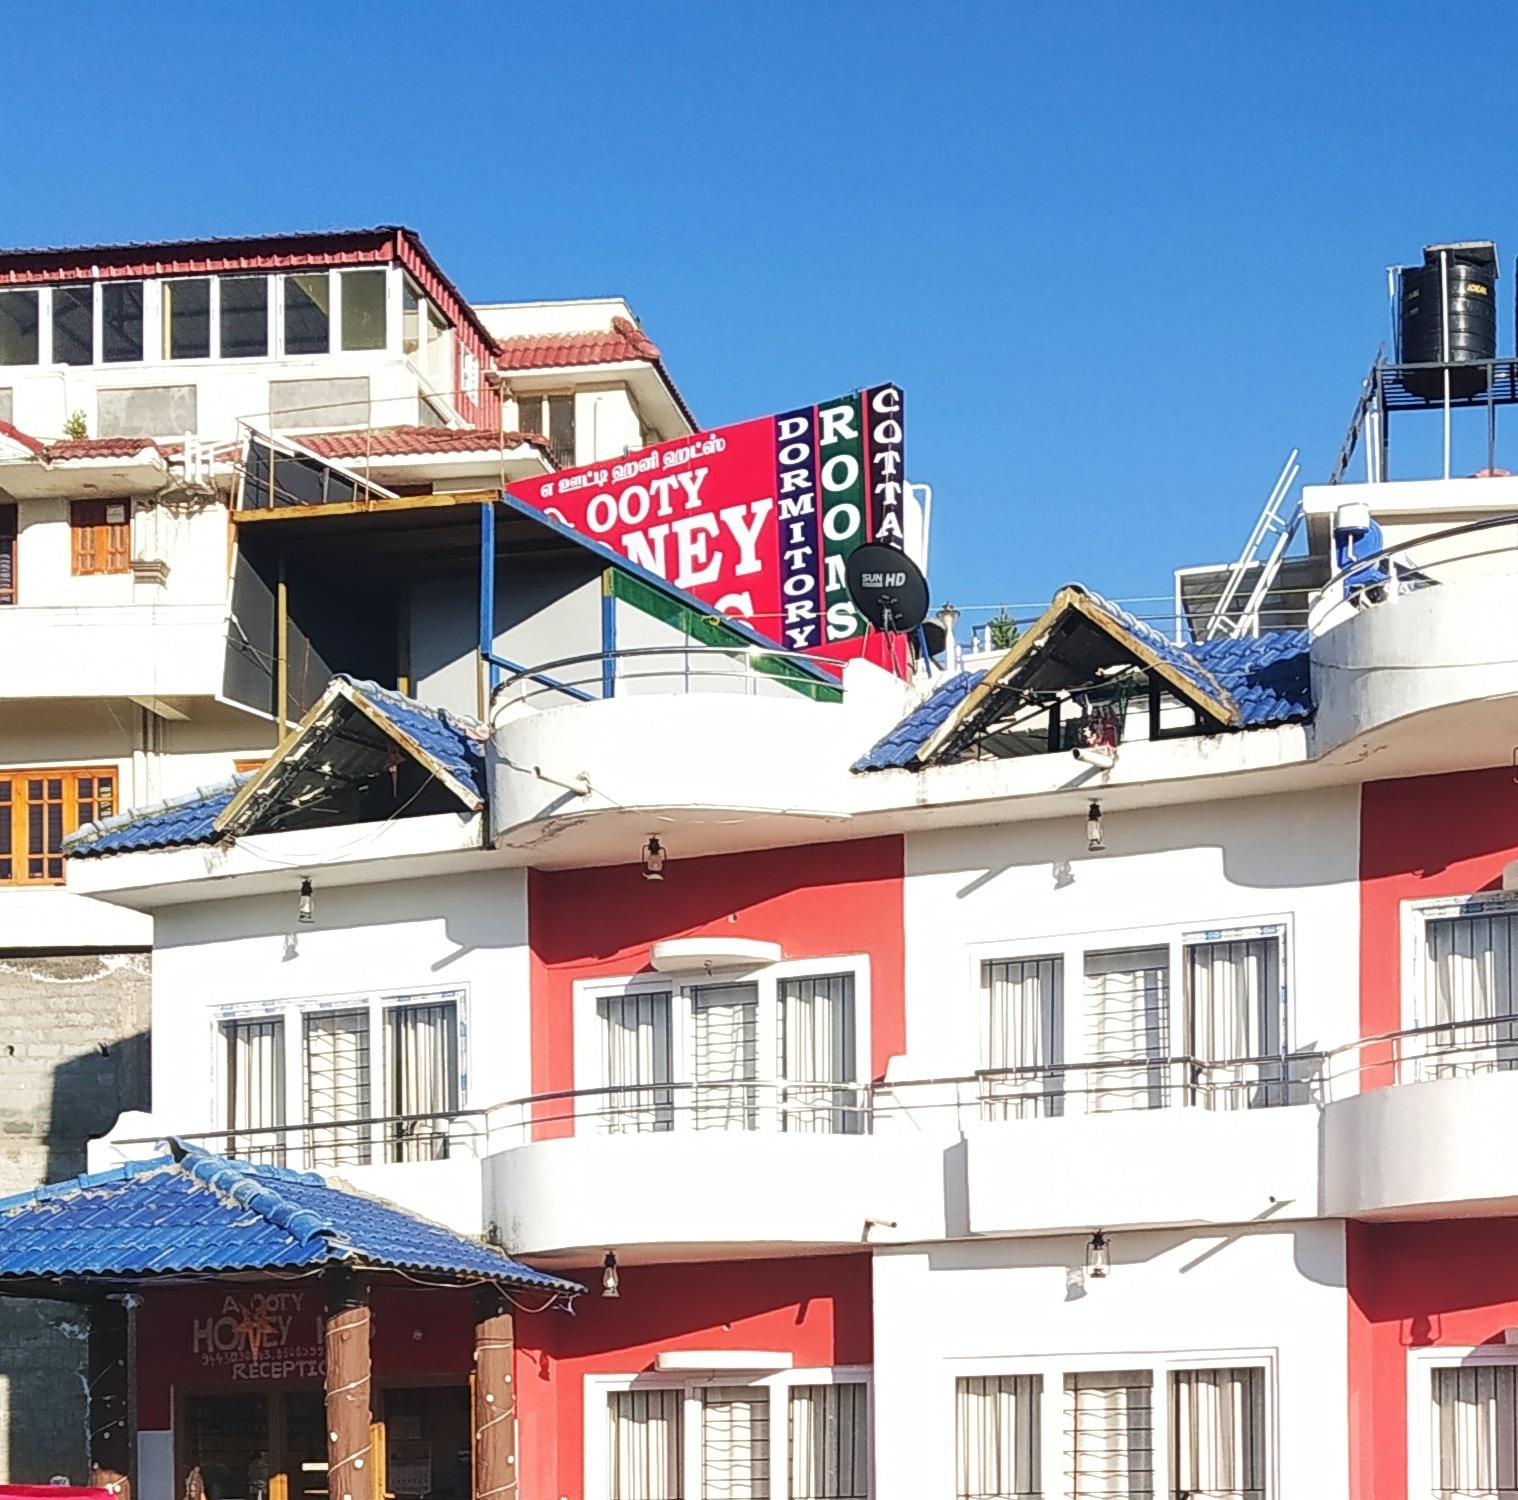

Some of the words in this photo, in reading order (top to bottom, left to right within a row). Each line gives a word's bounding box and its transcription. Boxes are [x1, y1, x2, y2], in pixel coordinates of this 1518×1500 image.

[586, 466, 709, 533] OOTY
[871, 387, 903, 550] COTTA
[597, 498, 774, 590] NEY
[777, 416, 817, 648] DORMITORY
[861, 573, 884, 583] SUN
[884, 572, 907, 588] HD
[222, 1295, 240, 1314] A
